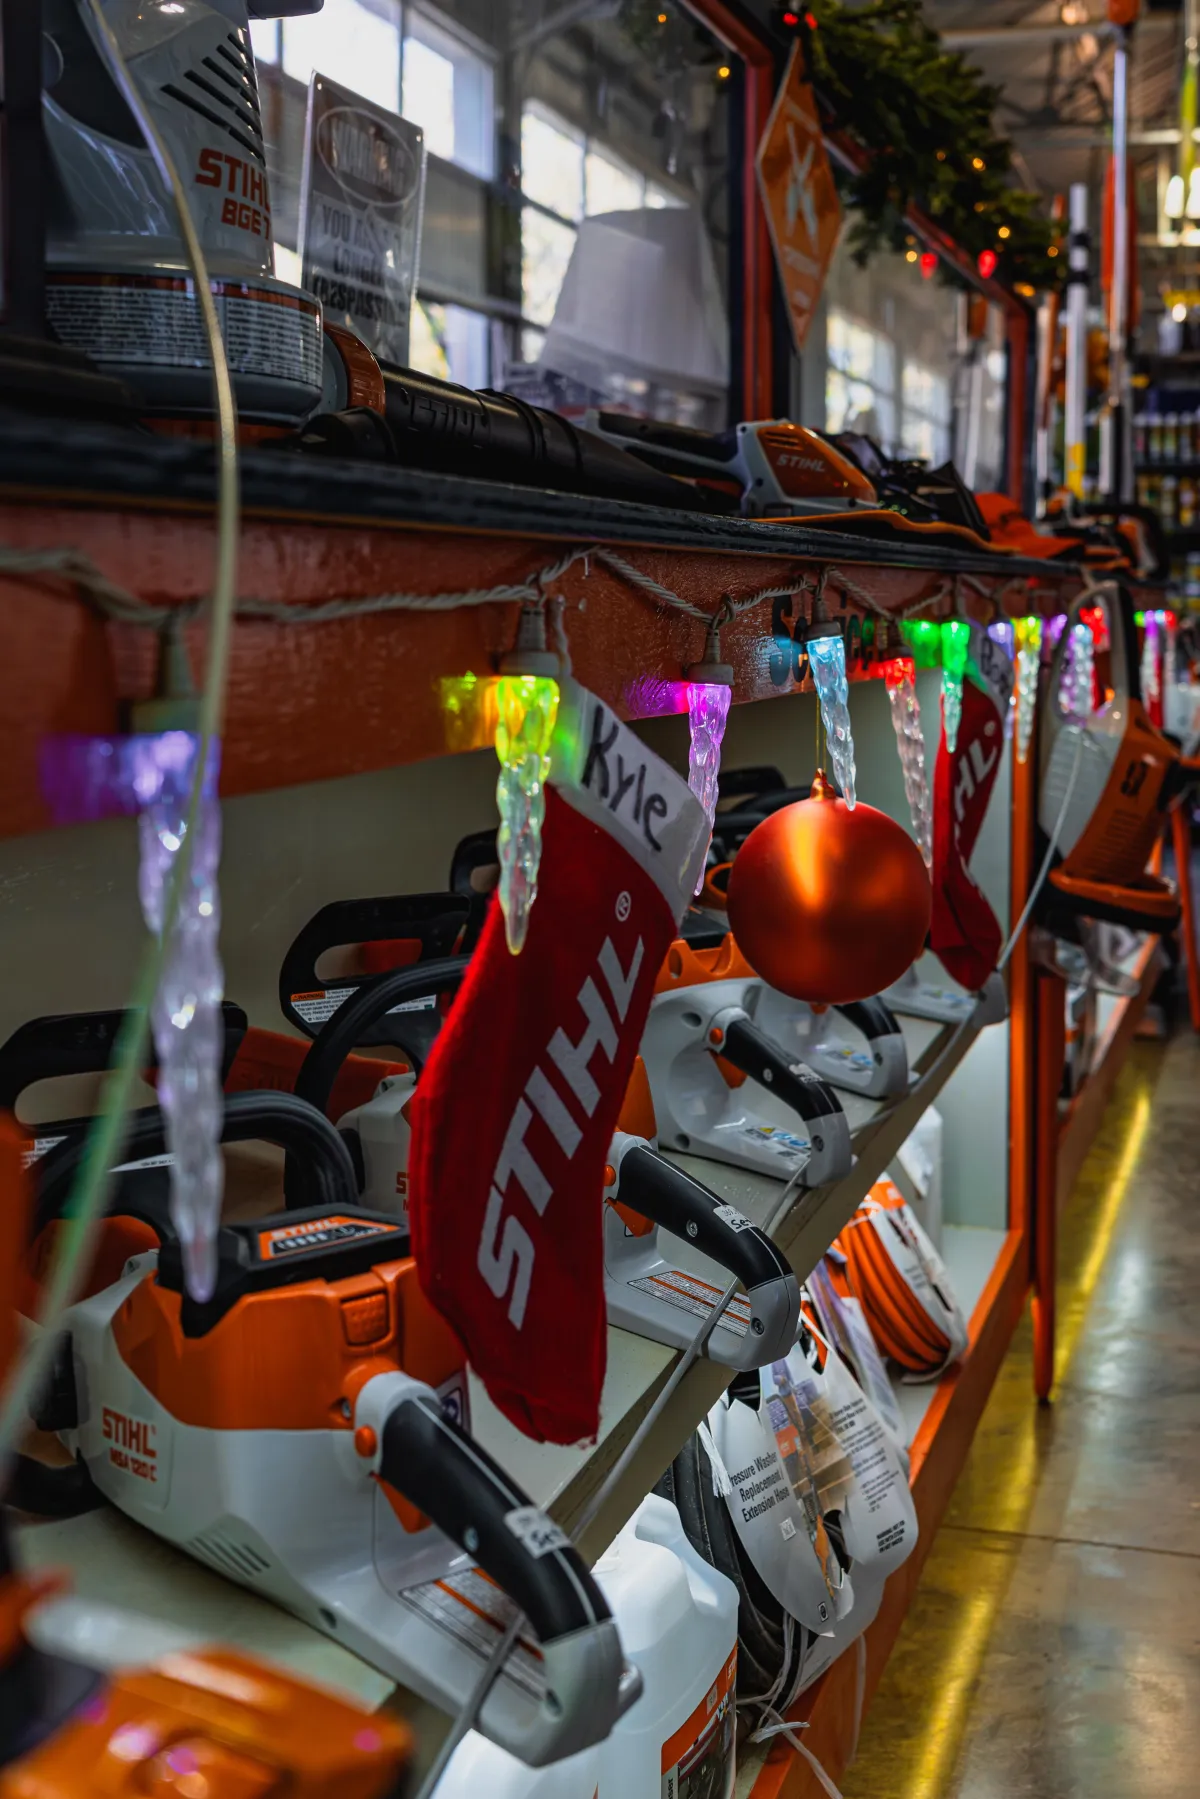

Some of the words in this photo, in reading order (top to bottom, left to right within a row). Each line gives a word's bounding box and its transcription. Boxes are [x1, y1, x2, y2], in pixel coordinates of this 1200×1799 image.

[195, 148, 270, 215] STIHL
[221, 197, 261, 236] BGE
[776, 453, 826, 473] STIHL
[580, 704, 669, 853] Kyle
[477, 935, 645, 1331] STIHL
[270, 1219, 332, 1240] STIHL
[102, 1406, 157, 1459] STIHL
[754, 1450, 778, 1474] Washer
[742, 1493, 777, 1523] Extension
[772, 1485, 791, 1508] Hose
